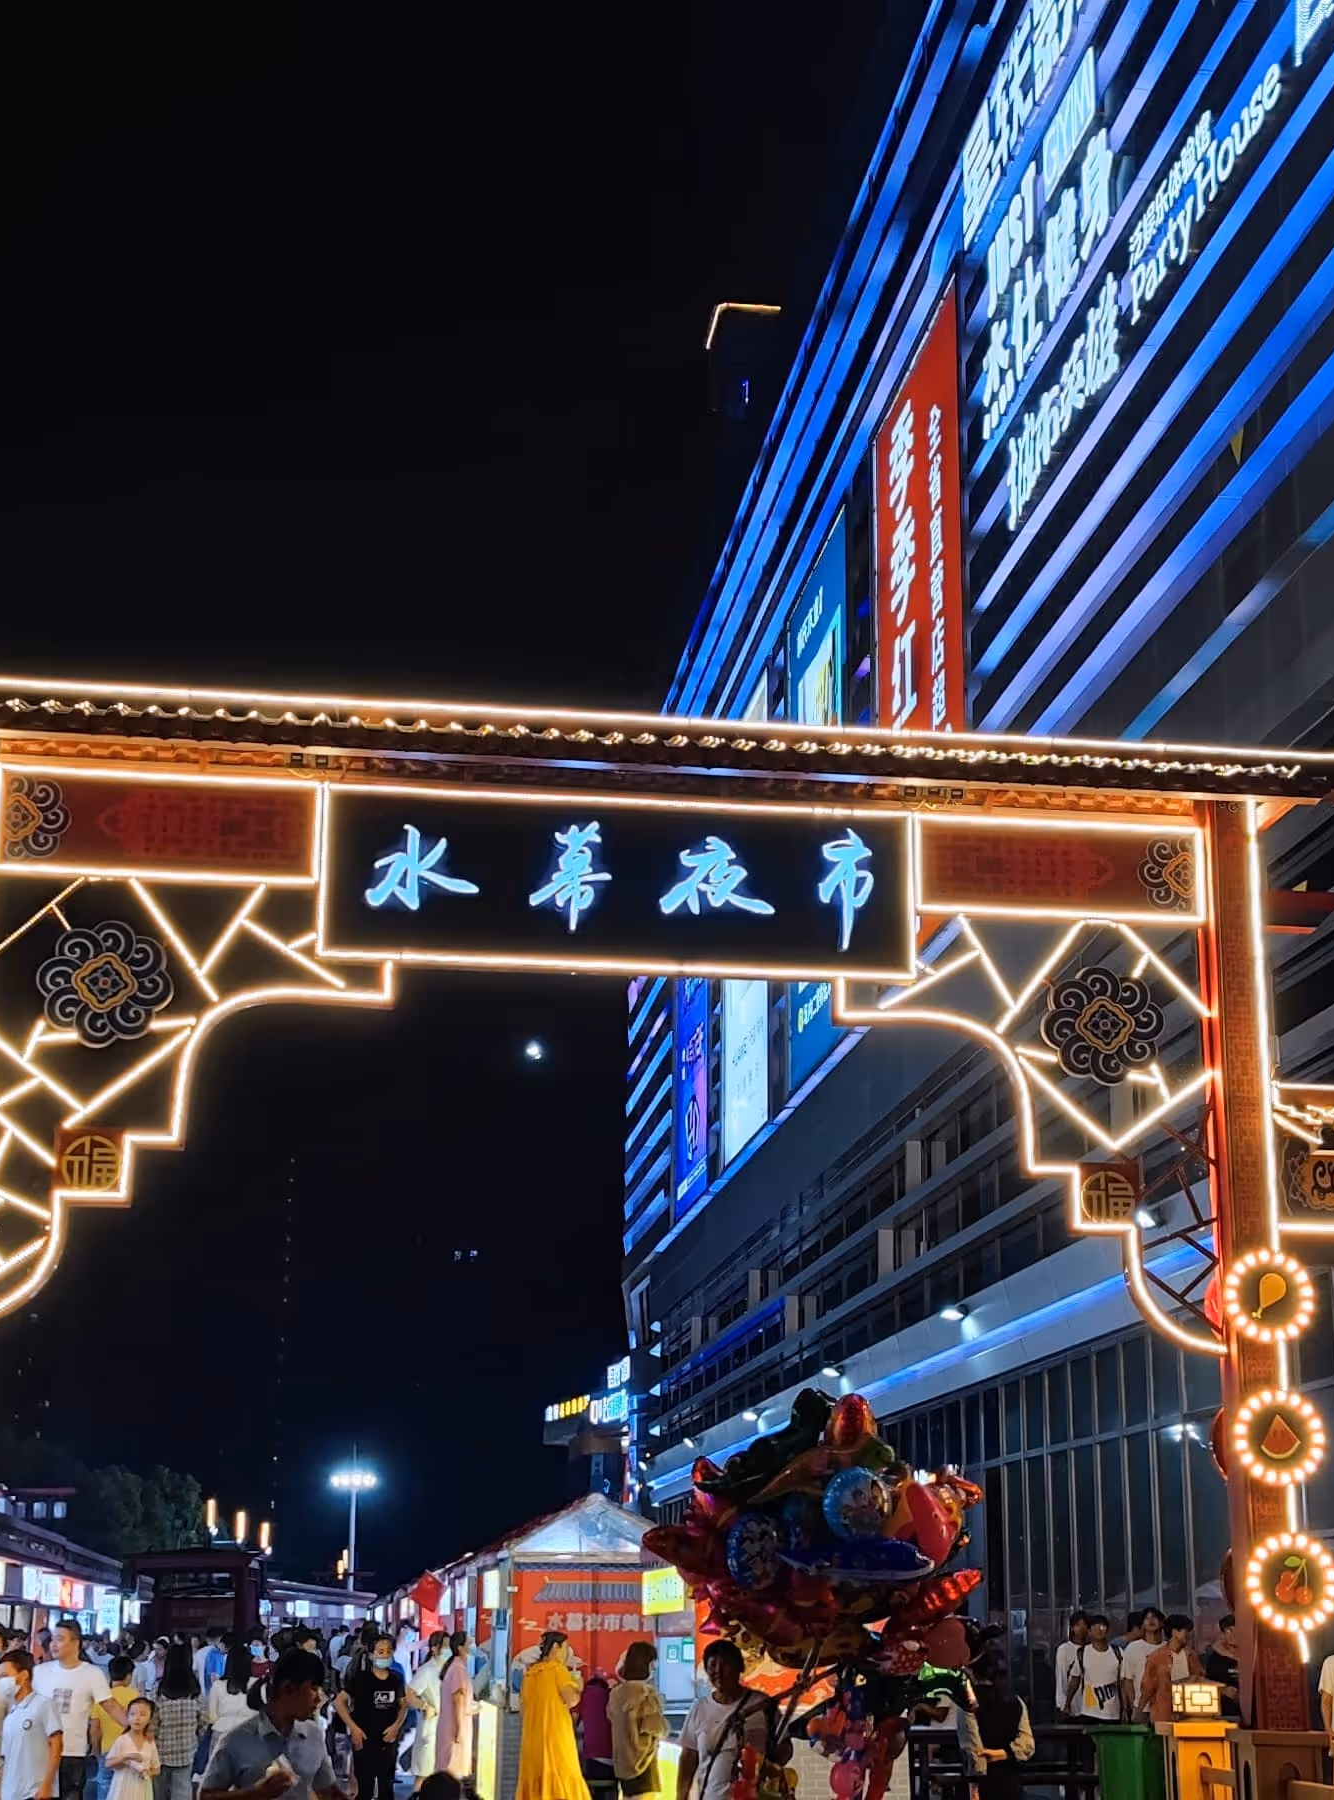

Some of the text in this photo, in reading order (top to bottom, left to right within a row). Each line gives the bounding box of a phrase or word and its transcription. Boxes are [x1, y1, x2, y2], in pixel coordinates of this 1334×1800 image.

[982, 127, 1114, 441] 杰仕健身
[1130, 63, 1282, 326] Party House
[889, 398, 917, 738] 季季红
[364, 820, 874, 953] 水幕夜市
